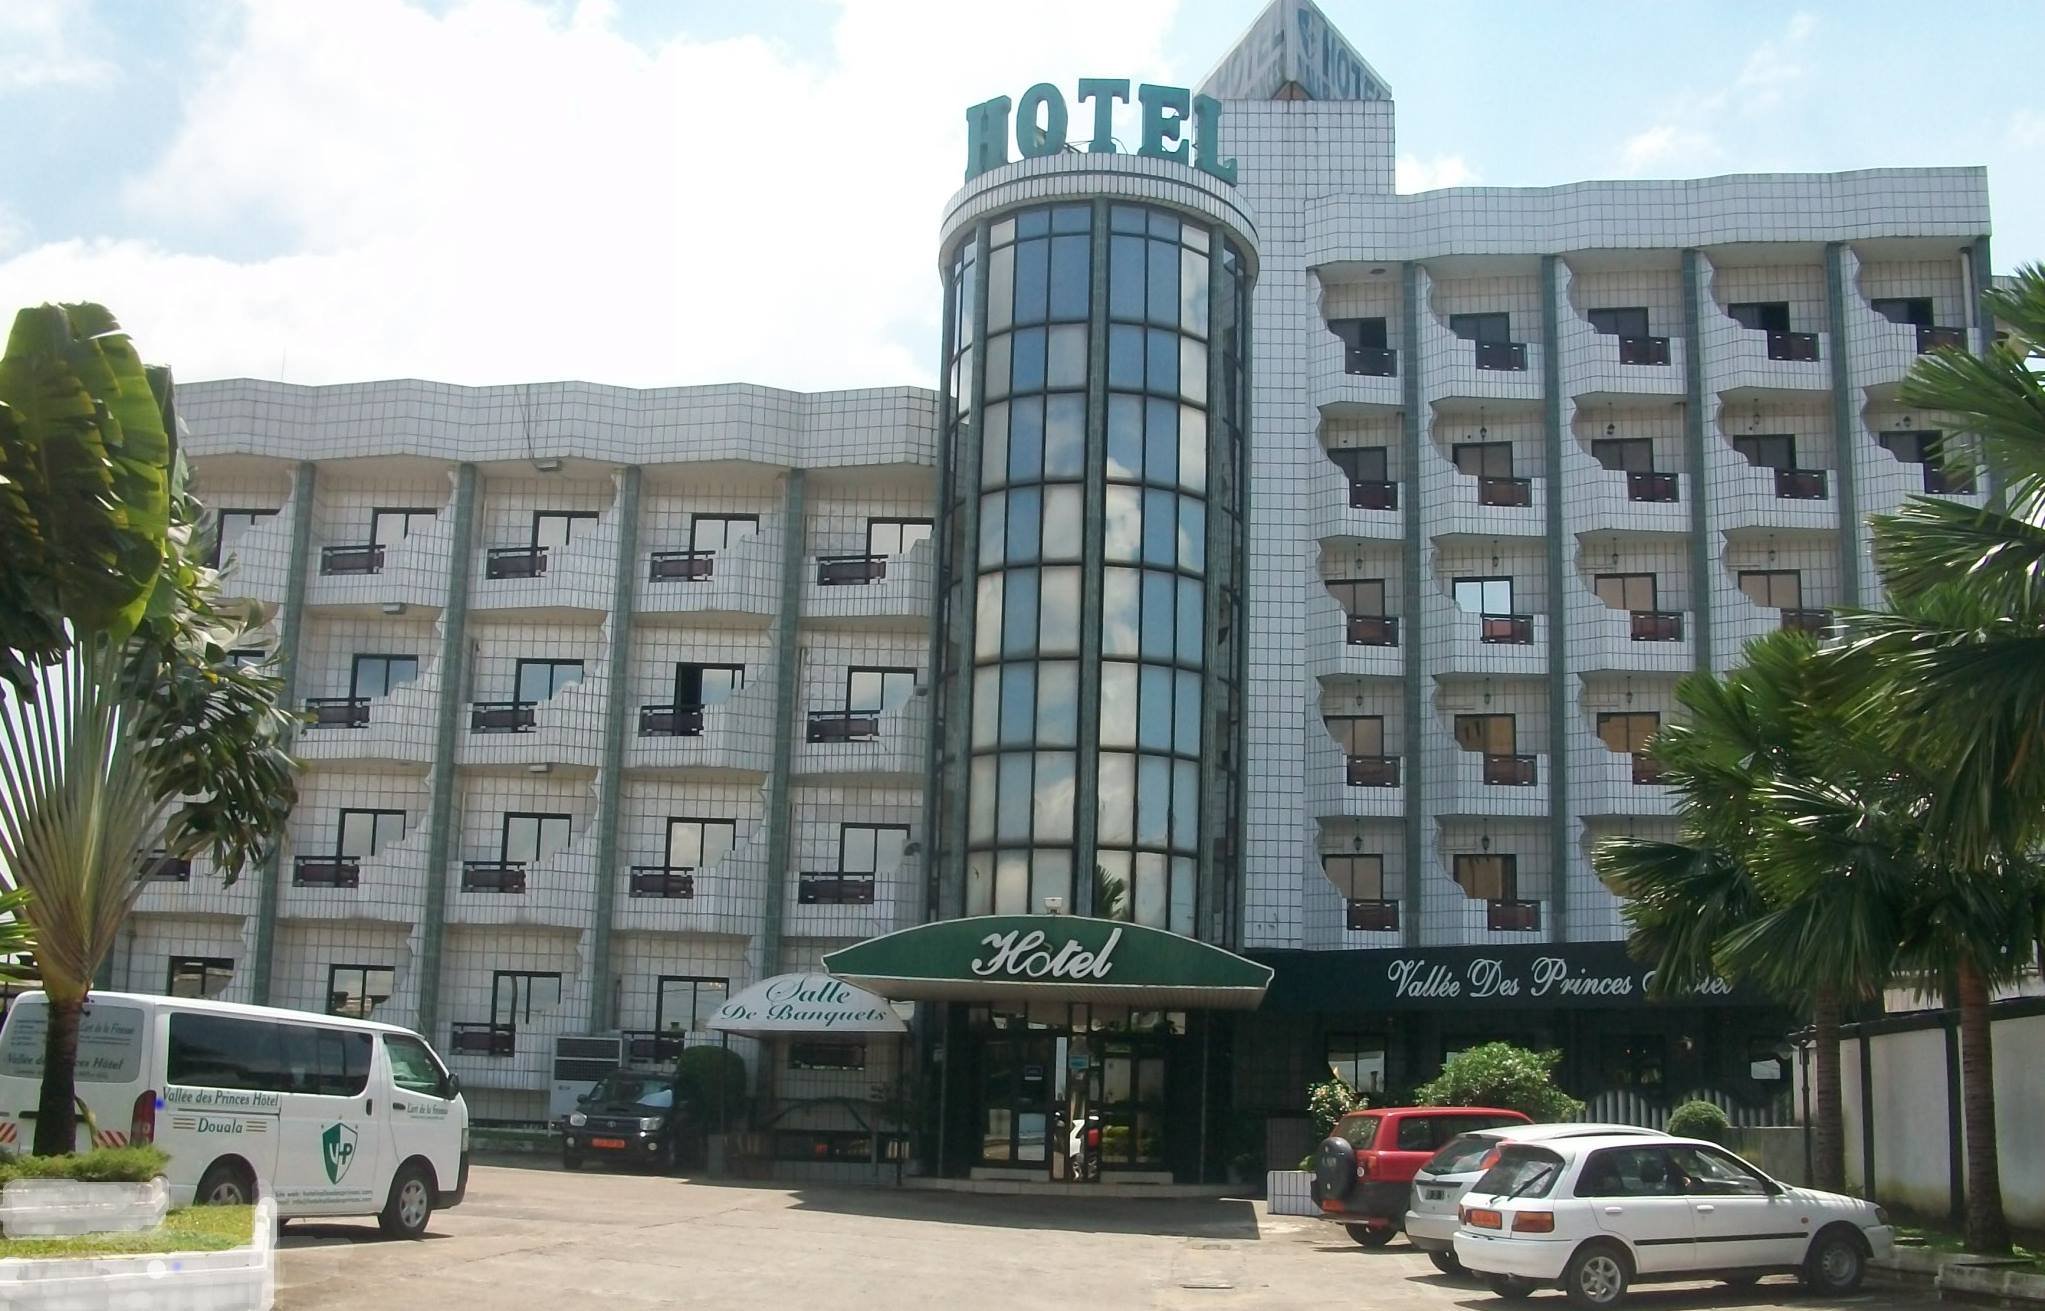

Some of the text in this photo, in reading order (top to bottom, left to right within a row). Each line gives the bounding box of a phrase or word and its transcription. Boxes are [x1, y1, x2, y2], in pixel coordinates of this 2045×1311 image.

[965, 78, 1237, 187] HOTEL
[766, 975, 851, 1004] Salle
[1387, 959, 1461, 997] Vallée
[1467, 958, 1520, 997] Des
[1530, 957, 1633, 996] Princes
[720, 1004, 887, 1027] De Banquets
[163, 1087, 280, 1107] Vallée des Princes Hôtel
[198, 1118, 243, 1134] Douala
